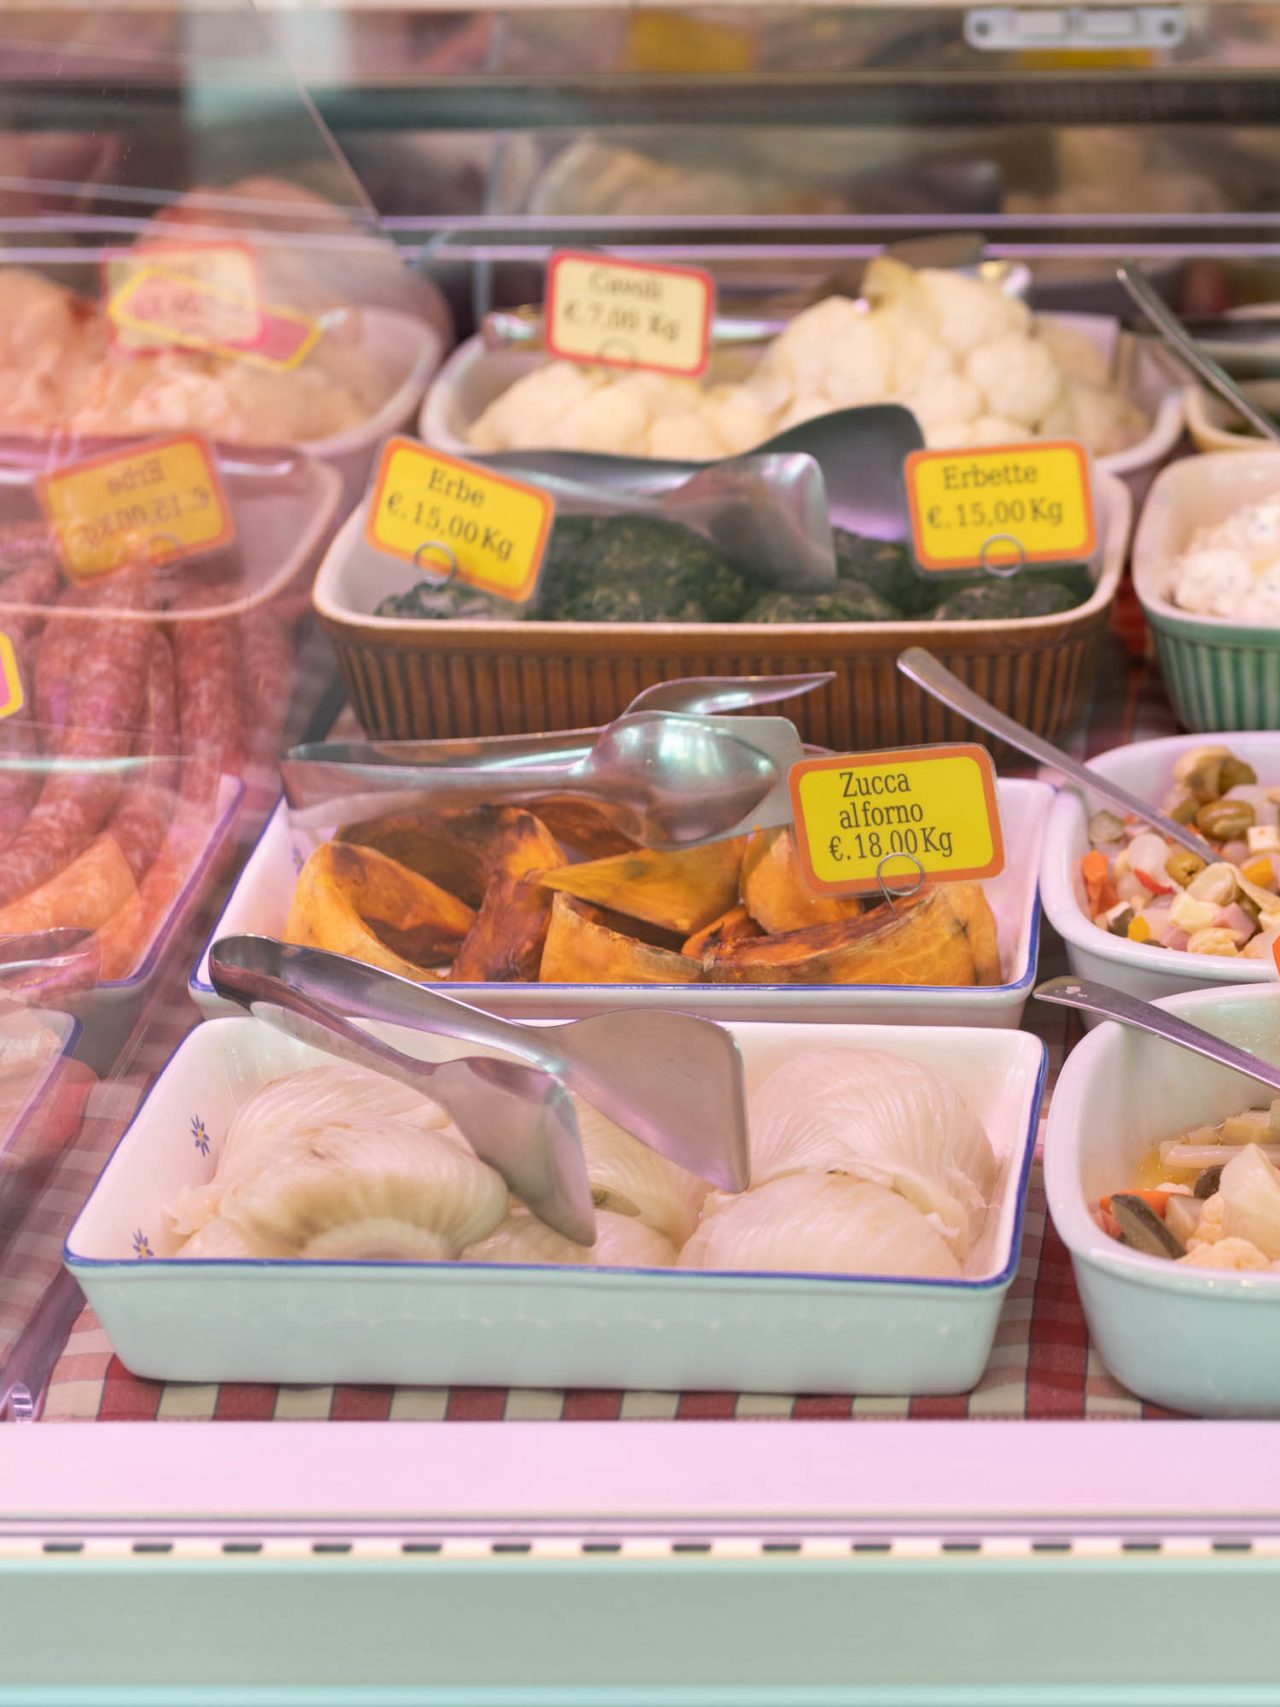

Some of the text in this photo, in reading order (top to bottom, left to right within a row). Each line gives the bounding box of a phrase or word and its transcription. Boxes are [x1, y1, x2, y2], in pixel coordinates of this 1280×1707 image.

[429, 467, 485, 507] Erbe
[942, 463, 1038, 490] Erbette
[839, 772, 912, 798] Zucca
